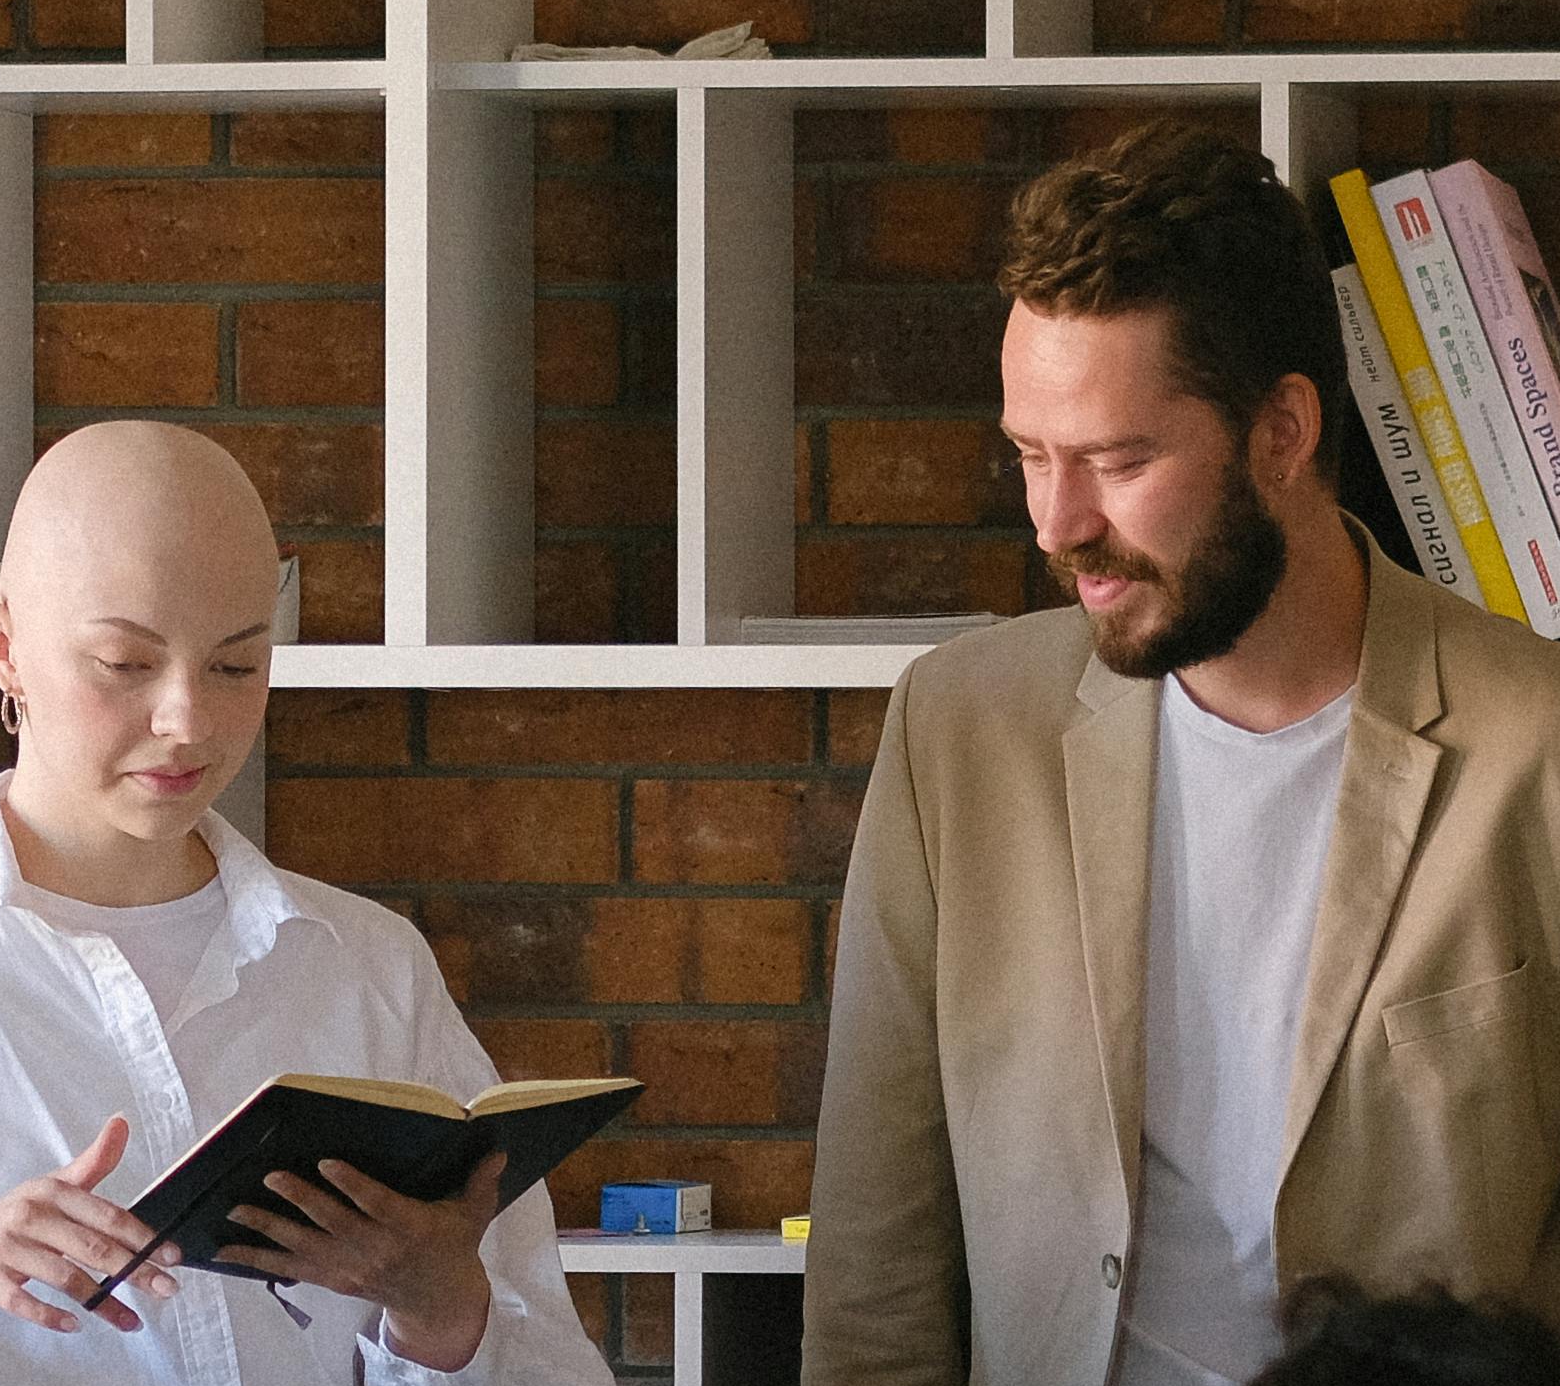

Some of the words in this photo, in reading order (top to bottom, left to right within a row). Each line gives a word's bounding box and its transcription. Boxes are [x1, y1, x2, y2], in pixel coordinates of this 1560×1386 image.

[1508, 337, 1549, 420] Spaces
[1378, 403, 1413, 460] шум
[1402, 468, 1422, 488] и
[1411, 495, 1458, 586] сигнал
